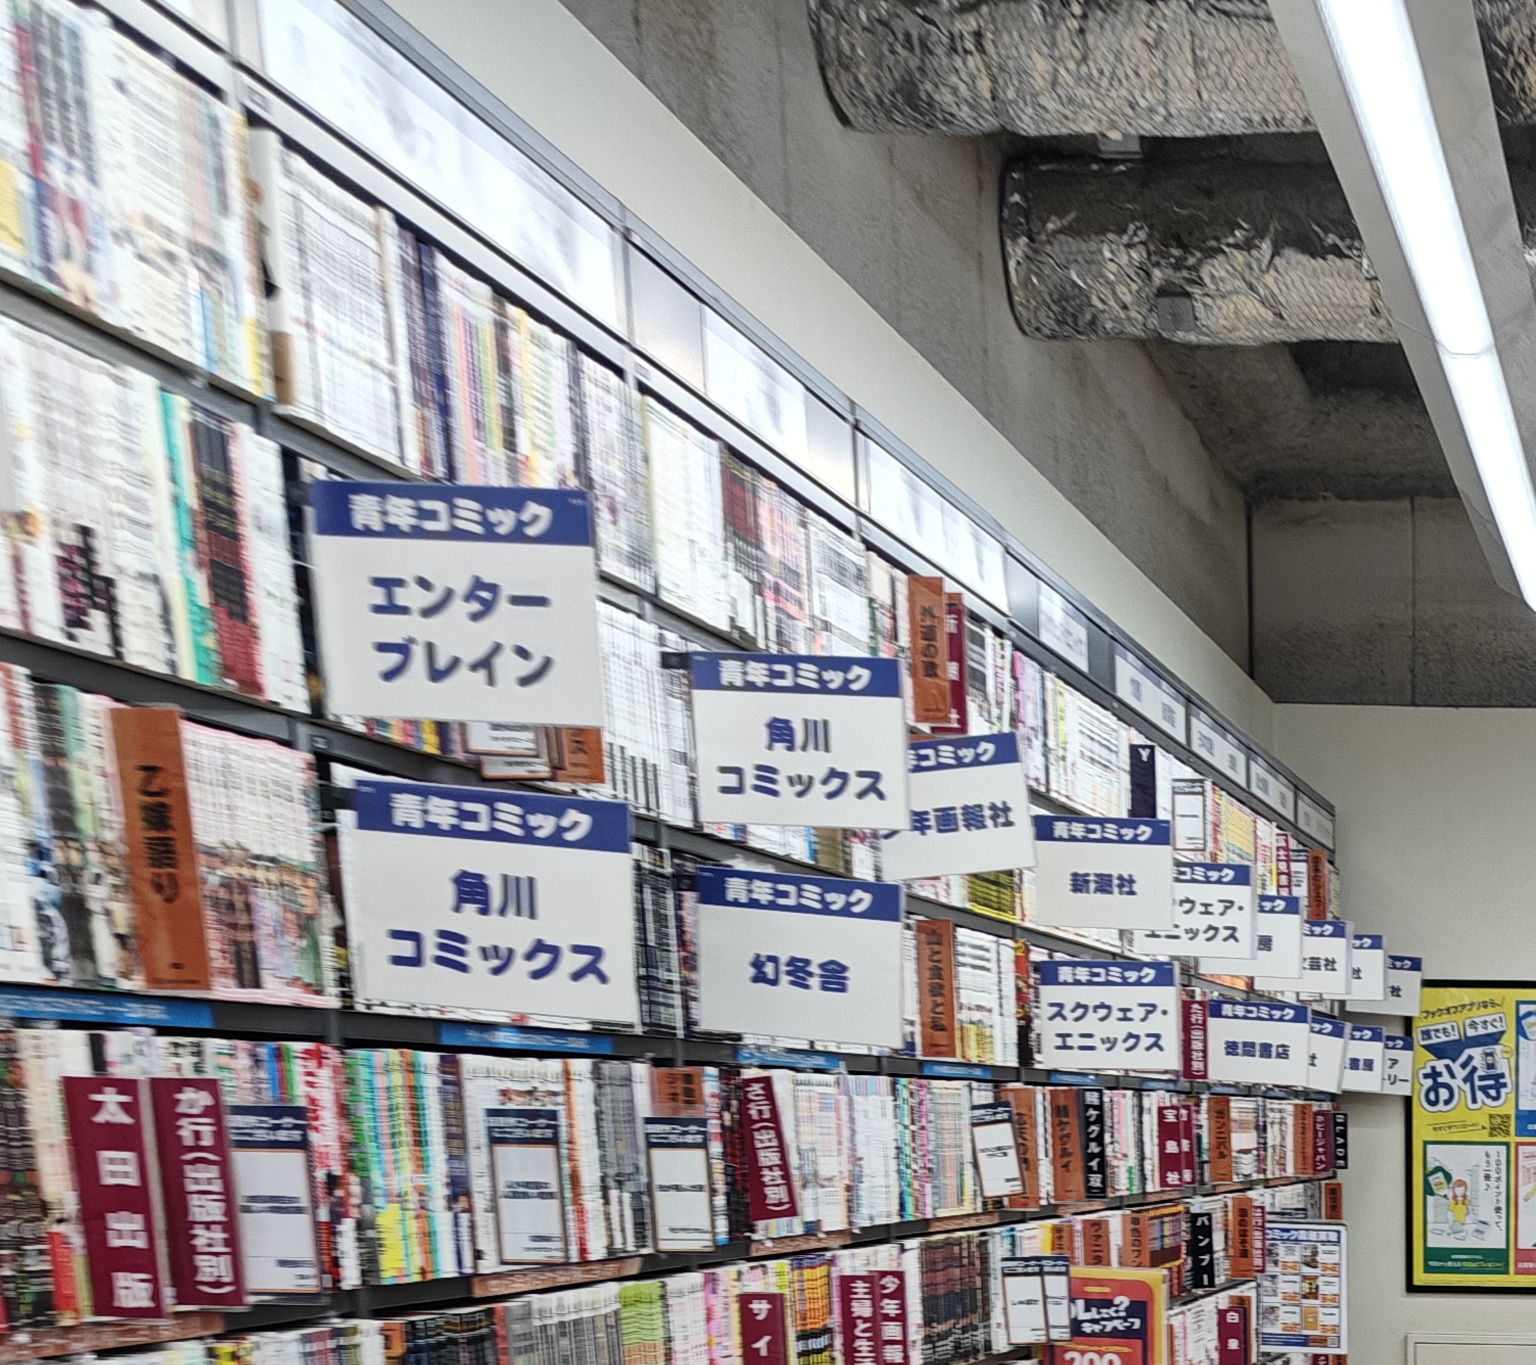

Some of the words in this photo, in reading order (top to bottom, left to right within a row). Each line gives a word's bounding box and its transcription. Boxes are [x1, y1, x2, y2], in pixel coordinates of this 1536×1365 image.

[349, 494, 554, 537] 青年コミック
[370, 575, 550, 622] エンター
[375, 641, 554, 689] ブレイン
[719, 660, 872, 691] 青年コミック
[766, 717, 831, 753] 角川
[717, 763, 886, 800] コミックス
[391, 800, 594, 842] 青年コミック
[882, 800, 1016, 838] 年画報社
[1052, 822, 1153, 842] 青年コミック
[451, 869, 538, 919] 角川
[724, 881, 873, 913] 青年コミック
[1069, 871, 1137, 896] 新潮社
[1177, 897, 1245, 917] ウェア・
[389, 928, 609, 984] コミックス
[750, 952, 850, 993] 幻冬舎
[1057, 966, 1156, 983] 青年コミック
[1221, 1005, 1295, 1020] 青年コミック
[1054, 1032, 1164, 1052] エニックス
[1224, 1042, 1290, 1060] 徳間書店
[1422, 1054, 1507, 1106] お得
[1164, 1108, 1180, 1185] 宝島社
[173, 1087, 236, 1293] か行(出版社別)
[1196, 1217, 1211, 1287] バンブー
